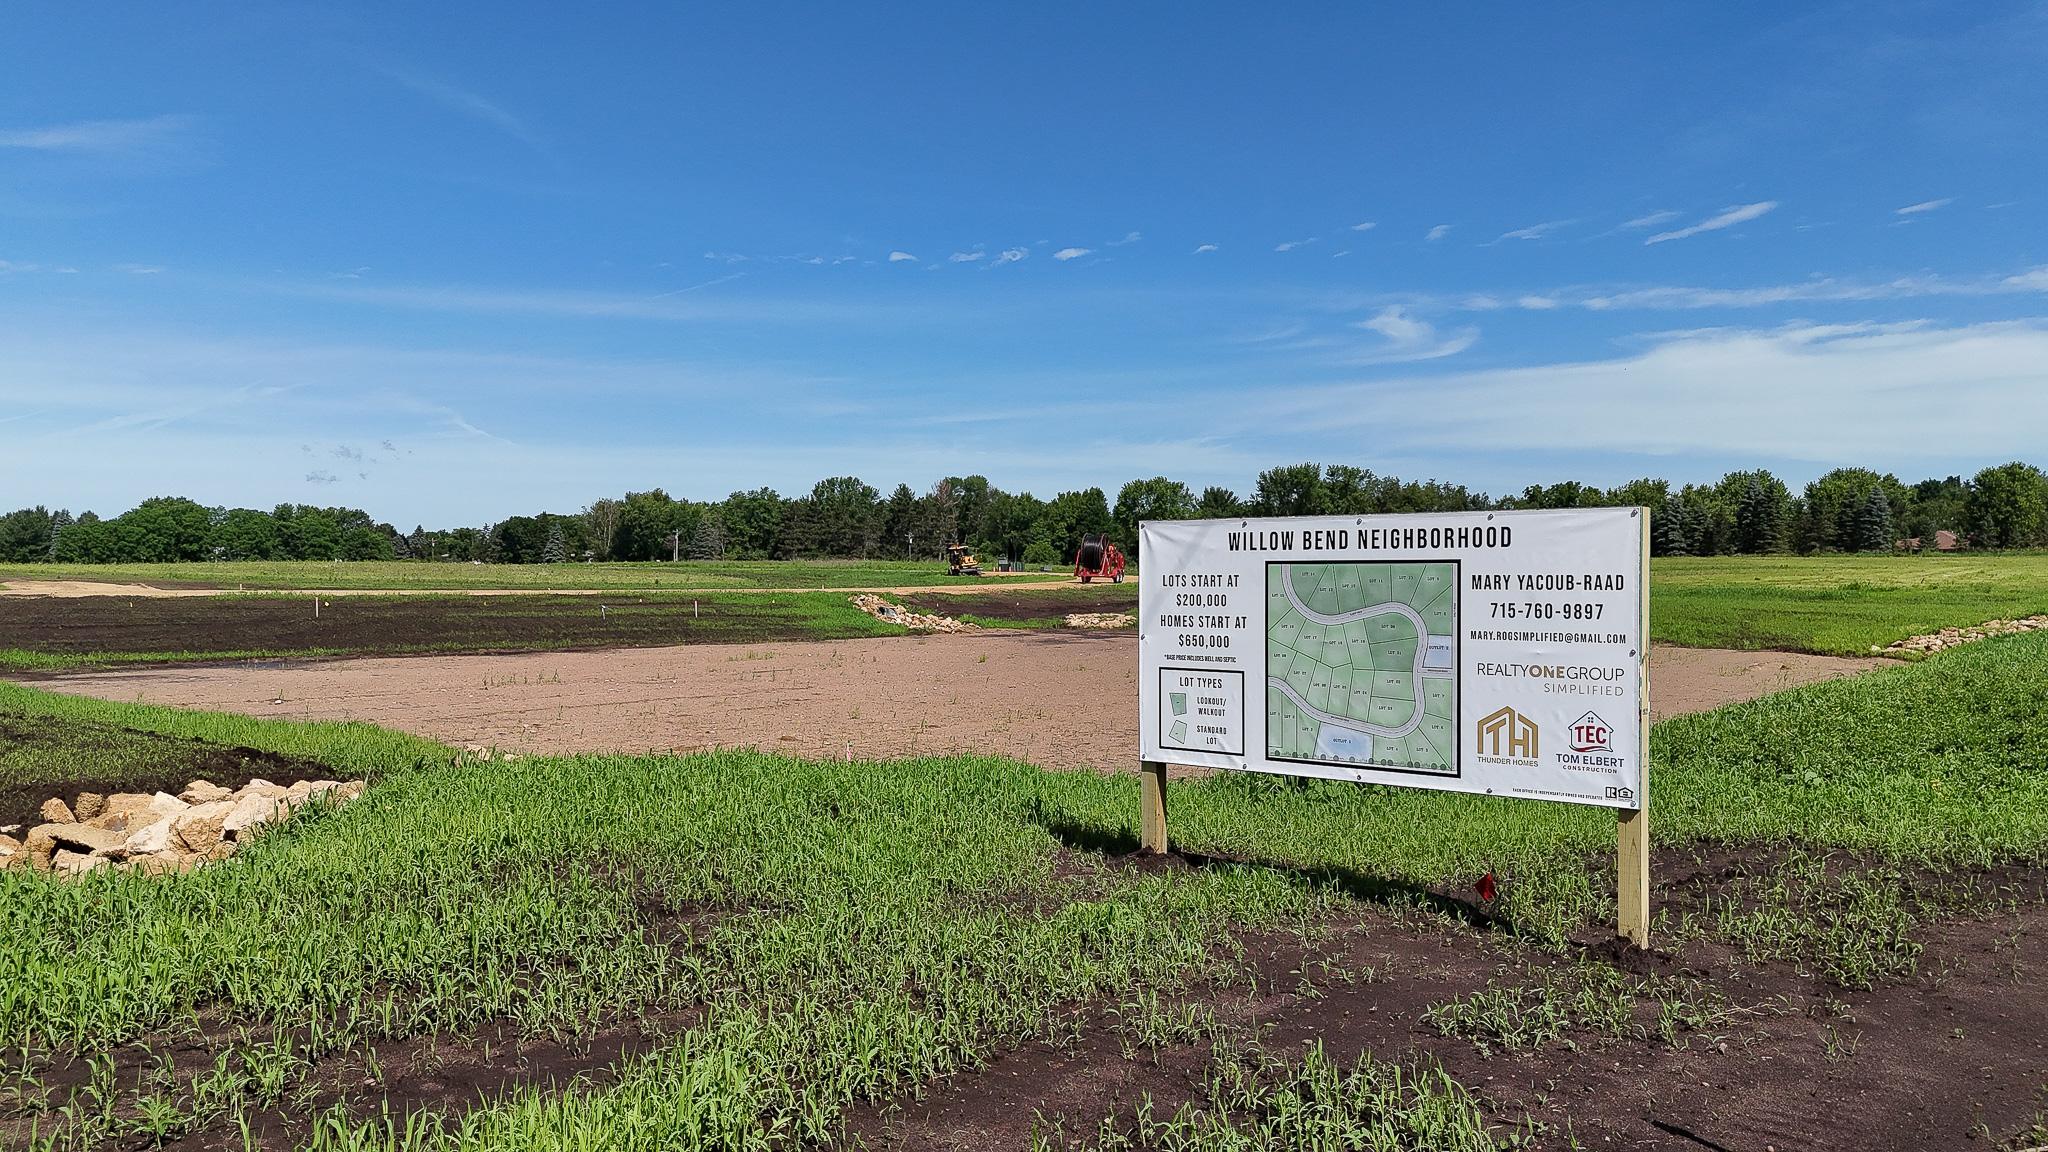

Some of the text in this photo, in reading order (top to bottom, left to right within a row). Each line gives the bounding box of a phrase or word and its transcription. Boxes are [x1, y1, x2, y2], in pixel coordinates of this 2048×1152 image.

[1228, 526, 1512, 551] WILLOW BEND NEIGHBORHOOD
[1162, 574, 1239, 587] LOTS START AT
[1471, 574, 1624, 591] MARY YACOUB-RAAD
[1176, 593, 1227, 608] $200,000
[1490, 602, 1603, 620] 715-760-9897
[1160, 614, 1247, 629] HOMES START AT
[1178, 634, 1230, 649] $650,000
[1470, 630, 1627, 644] MARY.ROGSIMPLIFIED@GMAIL.COM
[1179, 676, 1223, 689] LOT TYPES
[1543, 683, 1624, 697] SIMPLIFIED
[1197, 696, 1227, 707] LOOKOUT/
[1198, 707, 1226, 717] WALKOUT
[1196, 725, 1227, 735] STANDARD
[1574, 726, 1607, 744] TEC
[1206, 736, 1217, 745] LOT
[1477, 756, 1539, 767] THUNDER HOMES
[1556, 753, 1625, 768] TOM ELBERT
[1562, 765, 1617, 774] CONSTRUCTION
